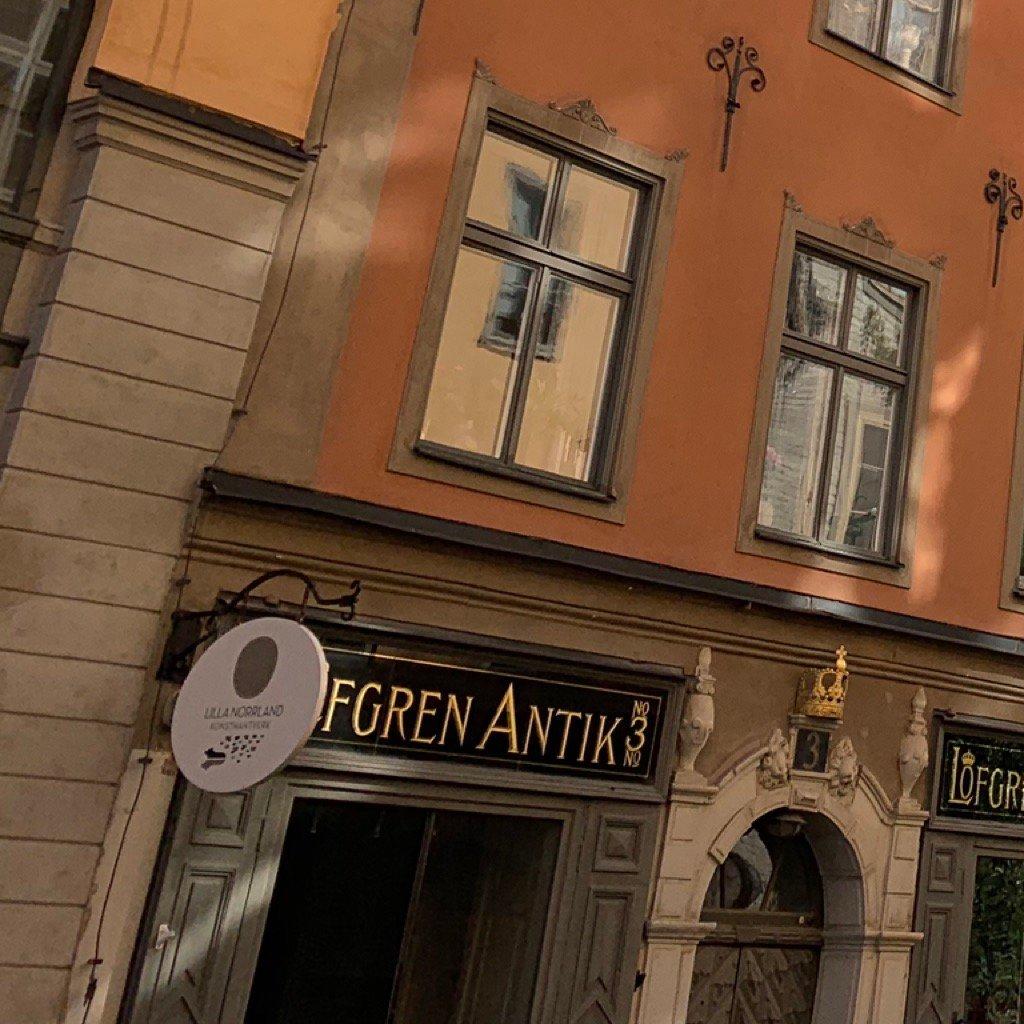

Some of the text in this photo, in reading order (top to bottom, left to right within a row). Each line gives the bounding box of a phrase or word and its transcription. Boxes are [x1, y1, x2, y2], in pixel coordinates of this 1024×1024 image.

[203, 704, 285, 720] LILLA NORRLAND
[316, 677, 623, 767] FGREN ANTIK
[625, 716, 648, 752] 3
[803, 731, 821, 770] 3
